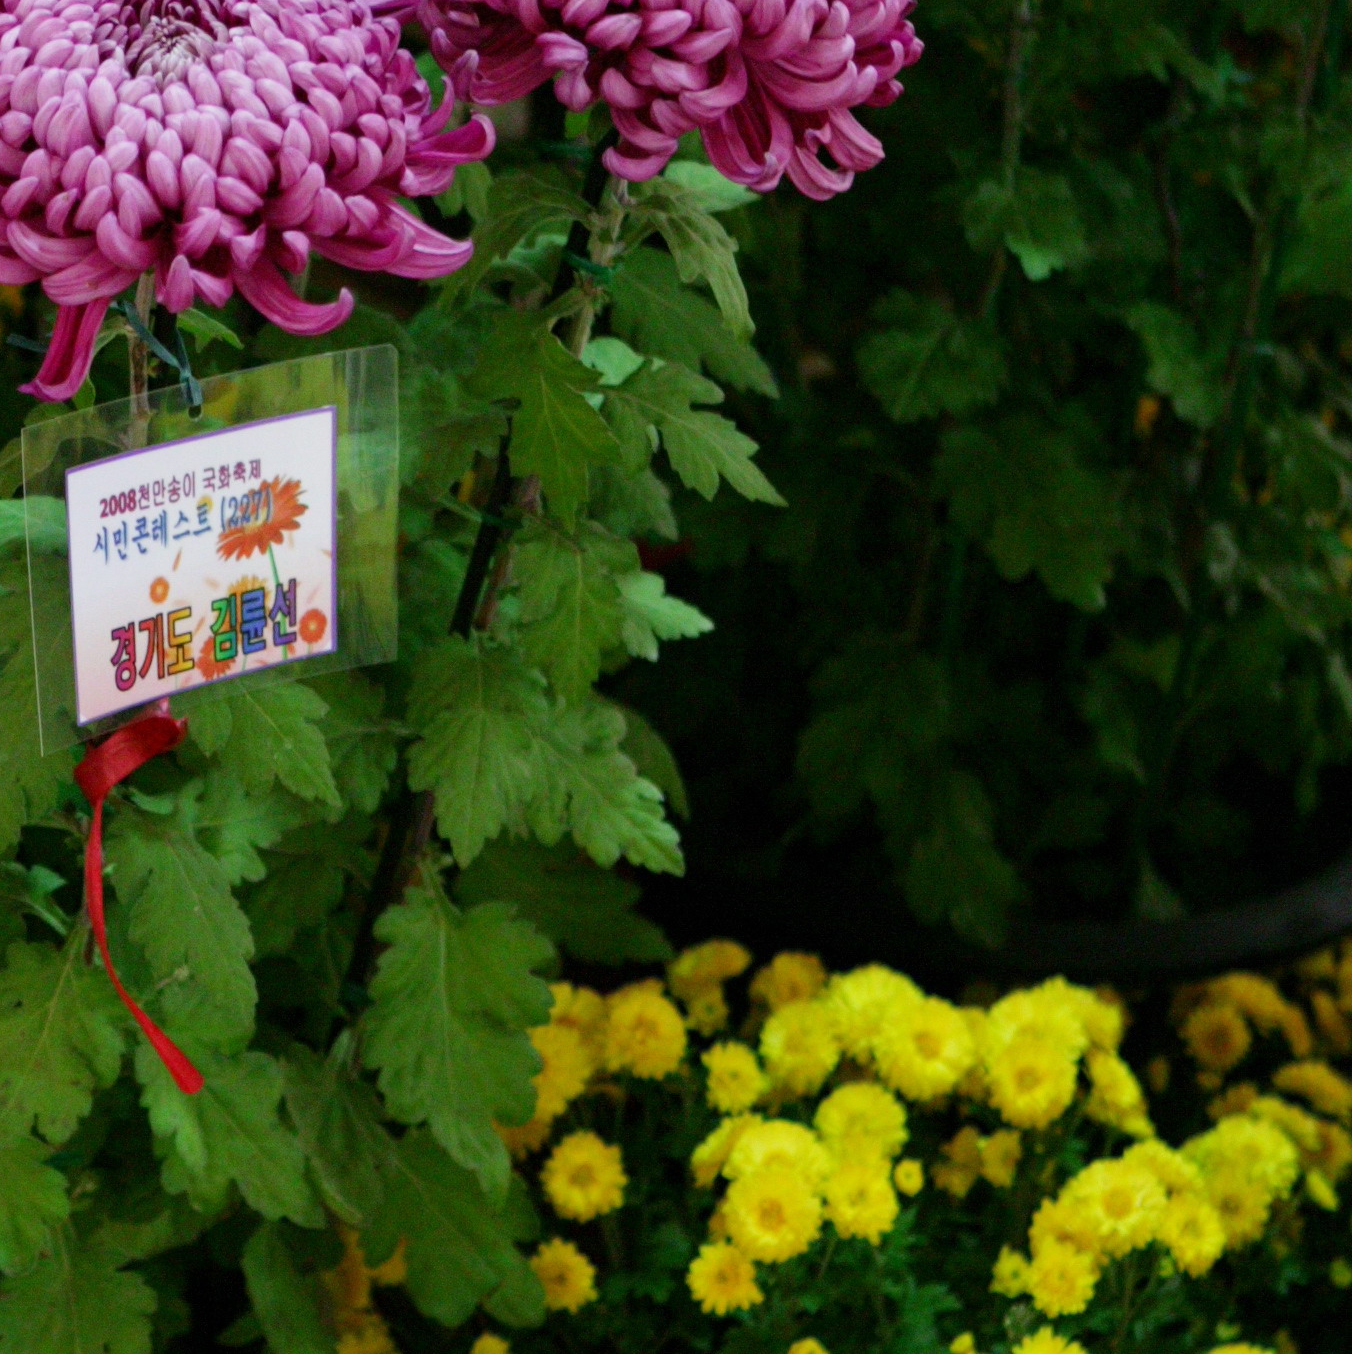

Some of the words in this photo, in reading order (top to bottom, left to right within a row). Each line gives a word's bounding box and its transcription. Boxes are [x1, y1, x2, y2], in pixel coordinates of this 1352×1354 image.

[92, 501, 212, 565] 시민콘테스트
[220, 485, 273, 534] (227)
[99, 471, 196, 519] 2008천만송이
[202, 458, 262, 493] 국화축제
[109, 605, 195, 692] 경기도
[210, 577, 297, 662] 김륜선
